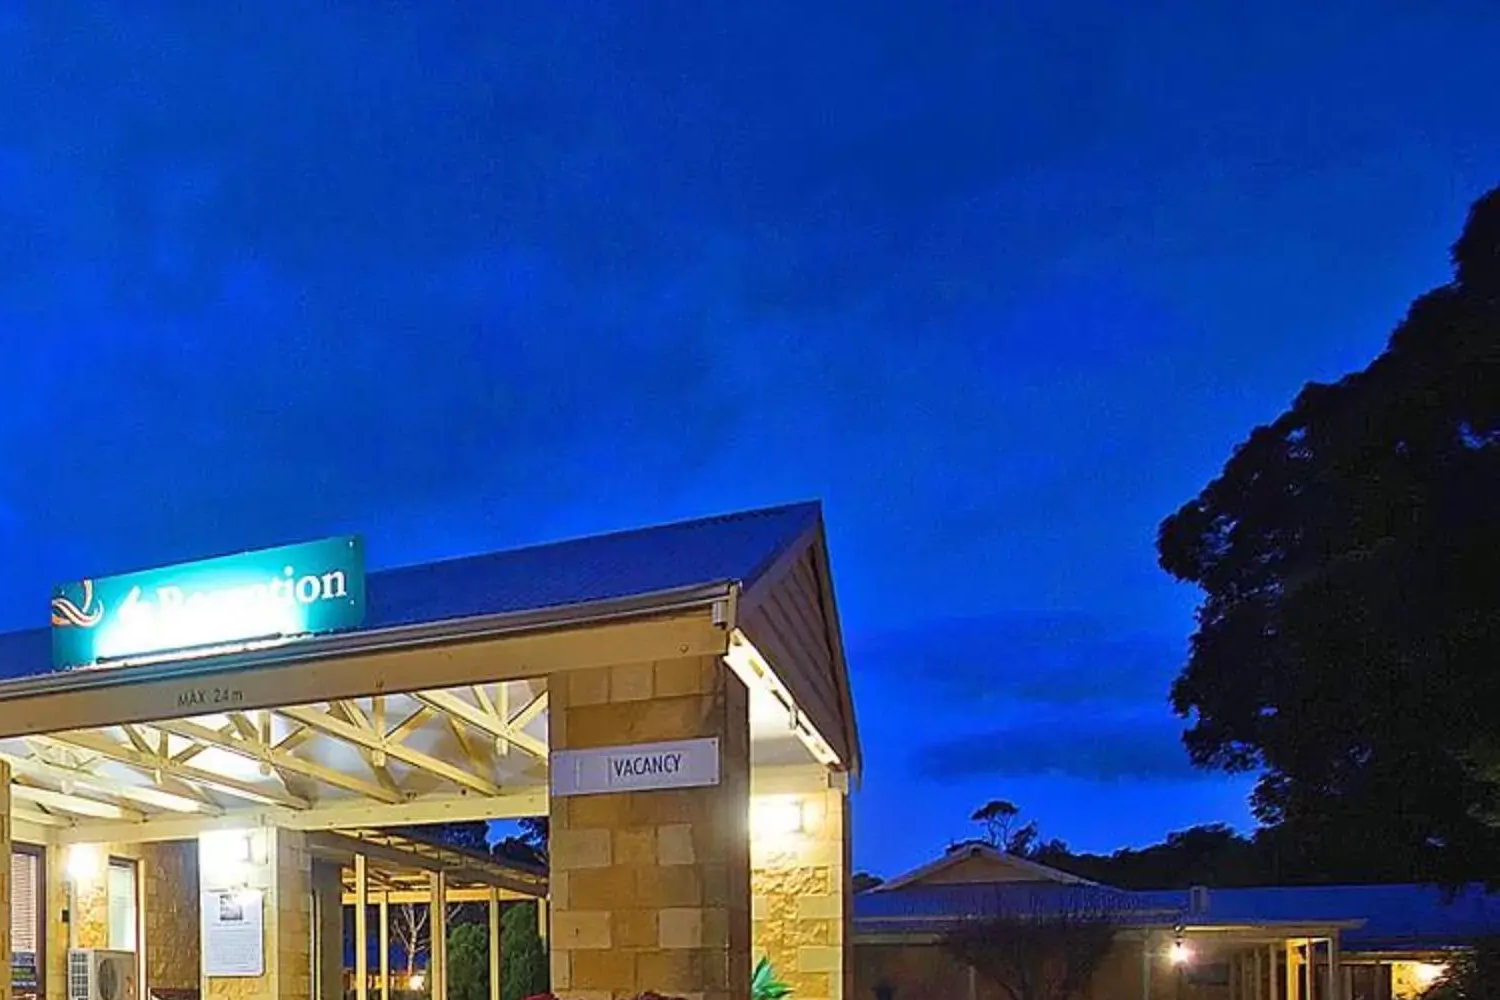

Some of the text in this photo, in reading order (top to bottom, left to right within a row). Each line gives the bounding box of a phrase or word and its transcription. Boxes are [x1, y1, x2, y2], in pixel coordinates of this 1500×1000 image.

[156, 565, 348, 627] Rtion
[177, 687, 206, 707] MAX
[613, 754, 681, 777] VACANCY
